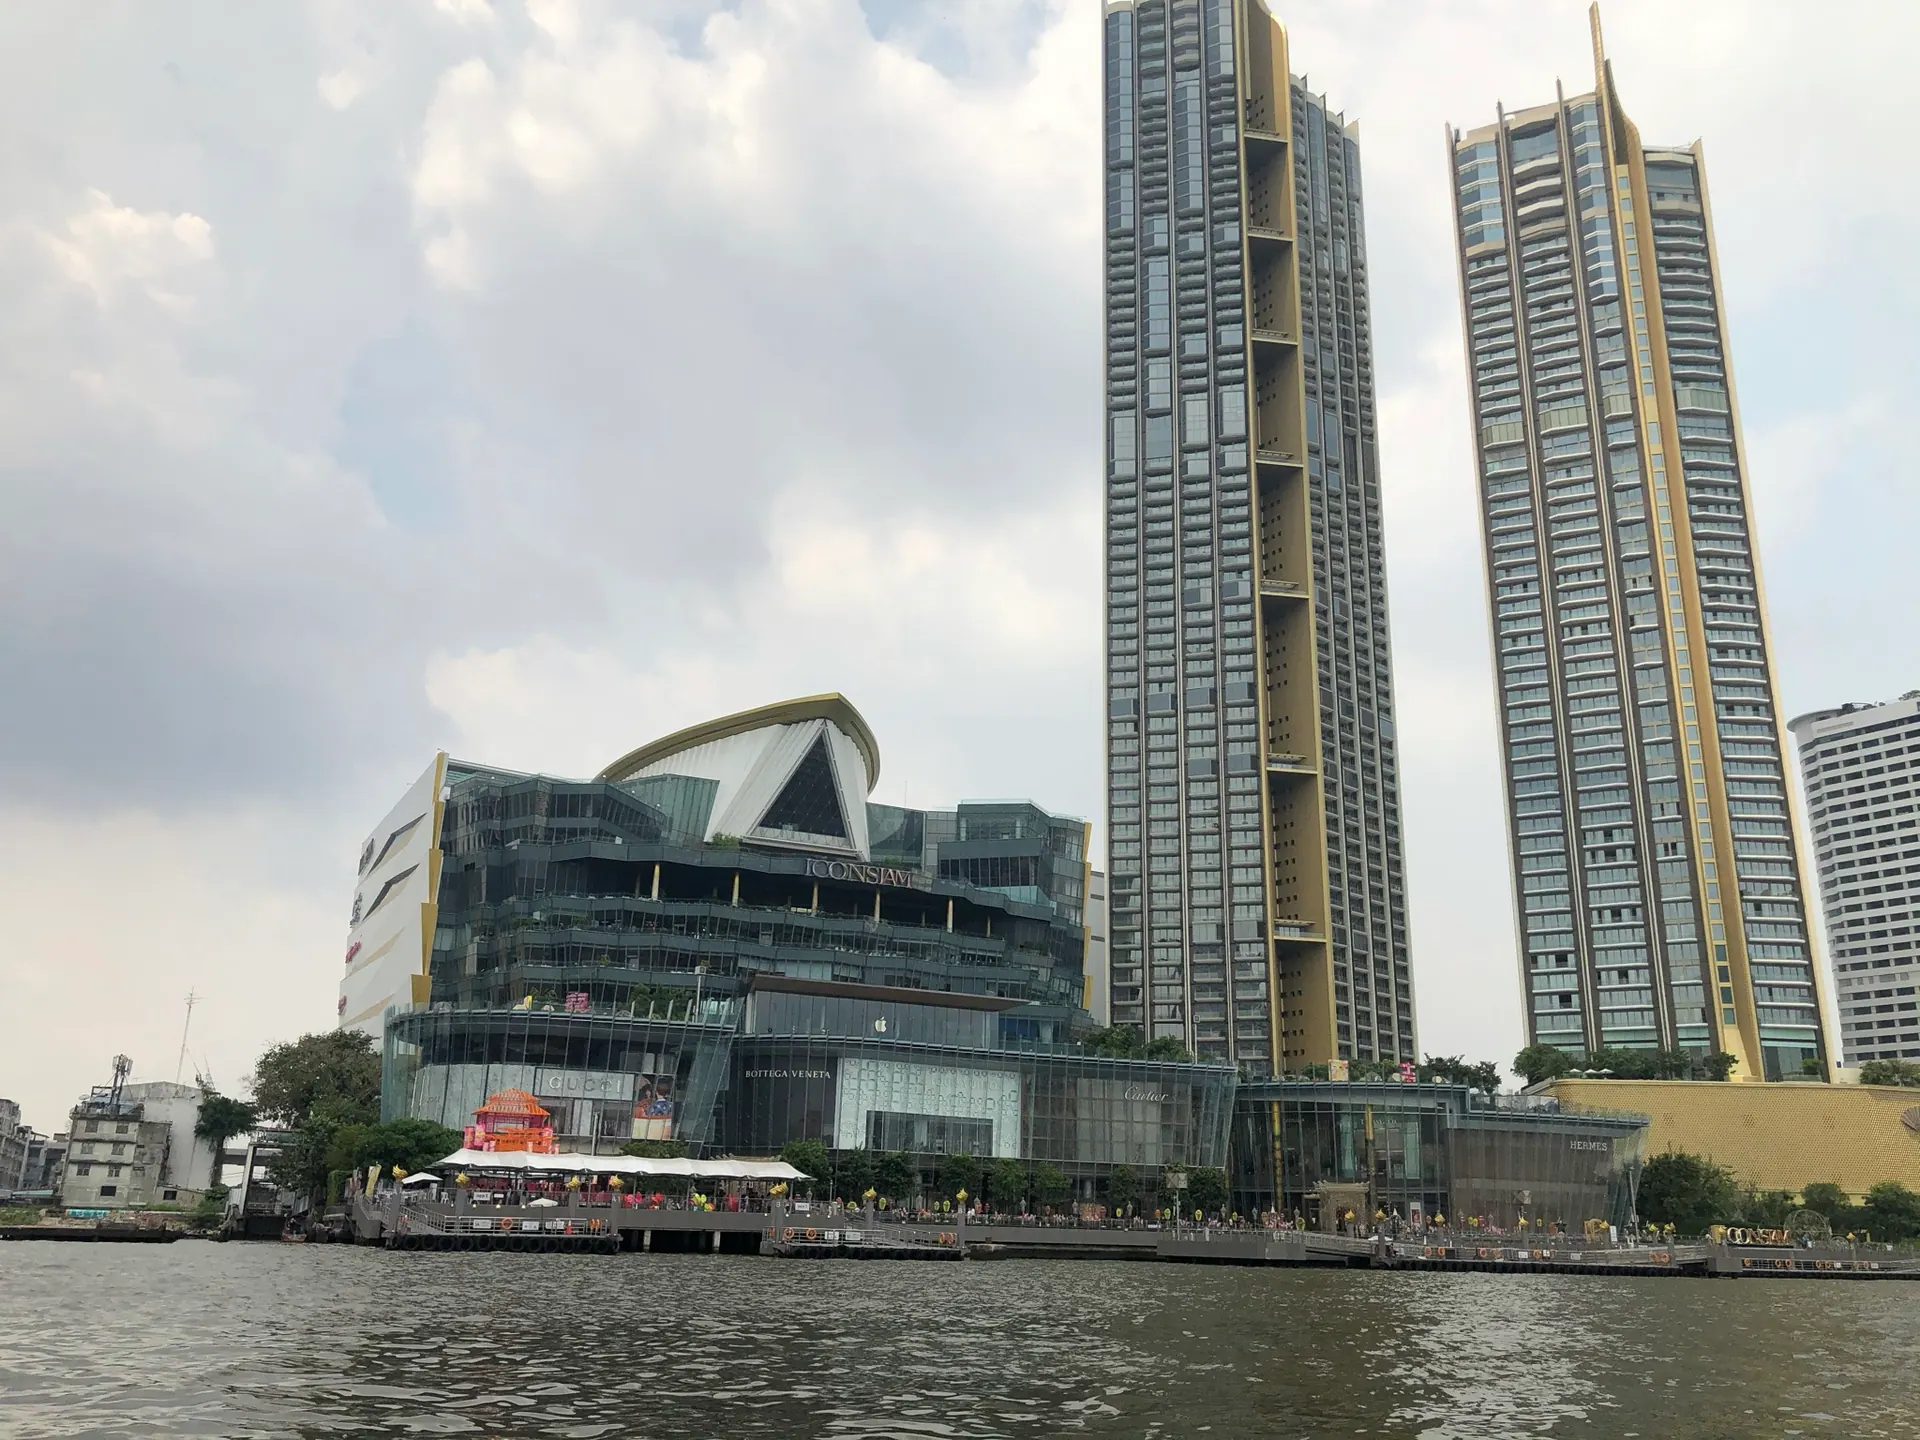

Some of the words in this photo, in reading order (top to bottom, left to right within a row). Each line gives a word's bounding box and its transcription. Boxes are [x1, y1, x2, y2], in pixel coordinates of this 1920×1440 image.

[805, 857, 913, 889] ICONSIAM
[745, 1070, 788, 1078] BOTTEGA
[791, 1070, 831, 1079] VENETA
[549, 1076, 621, 1093] GUCCI
[1124, 1085, 1169, 1102] Cartier
